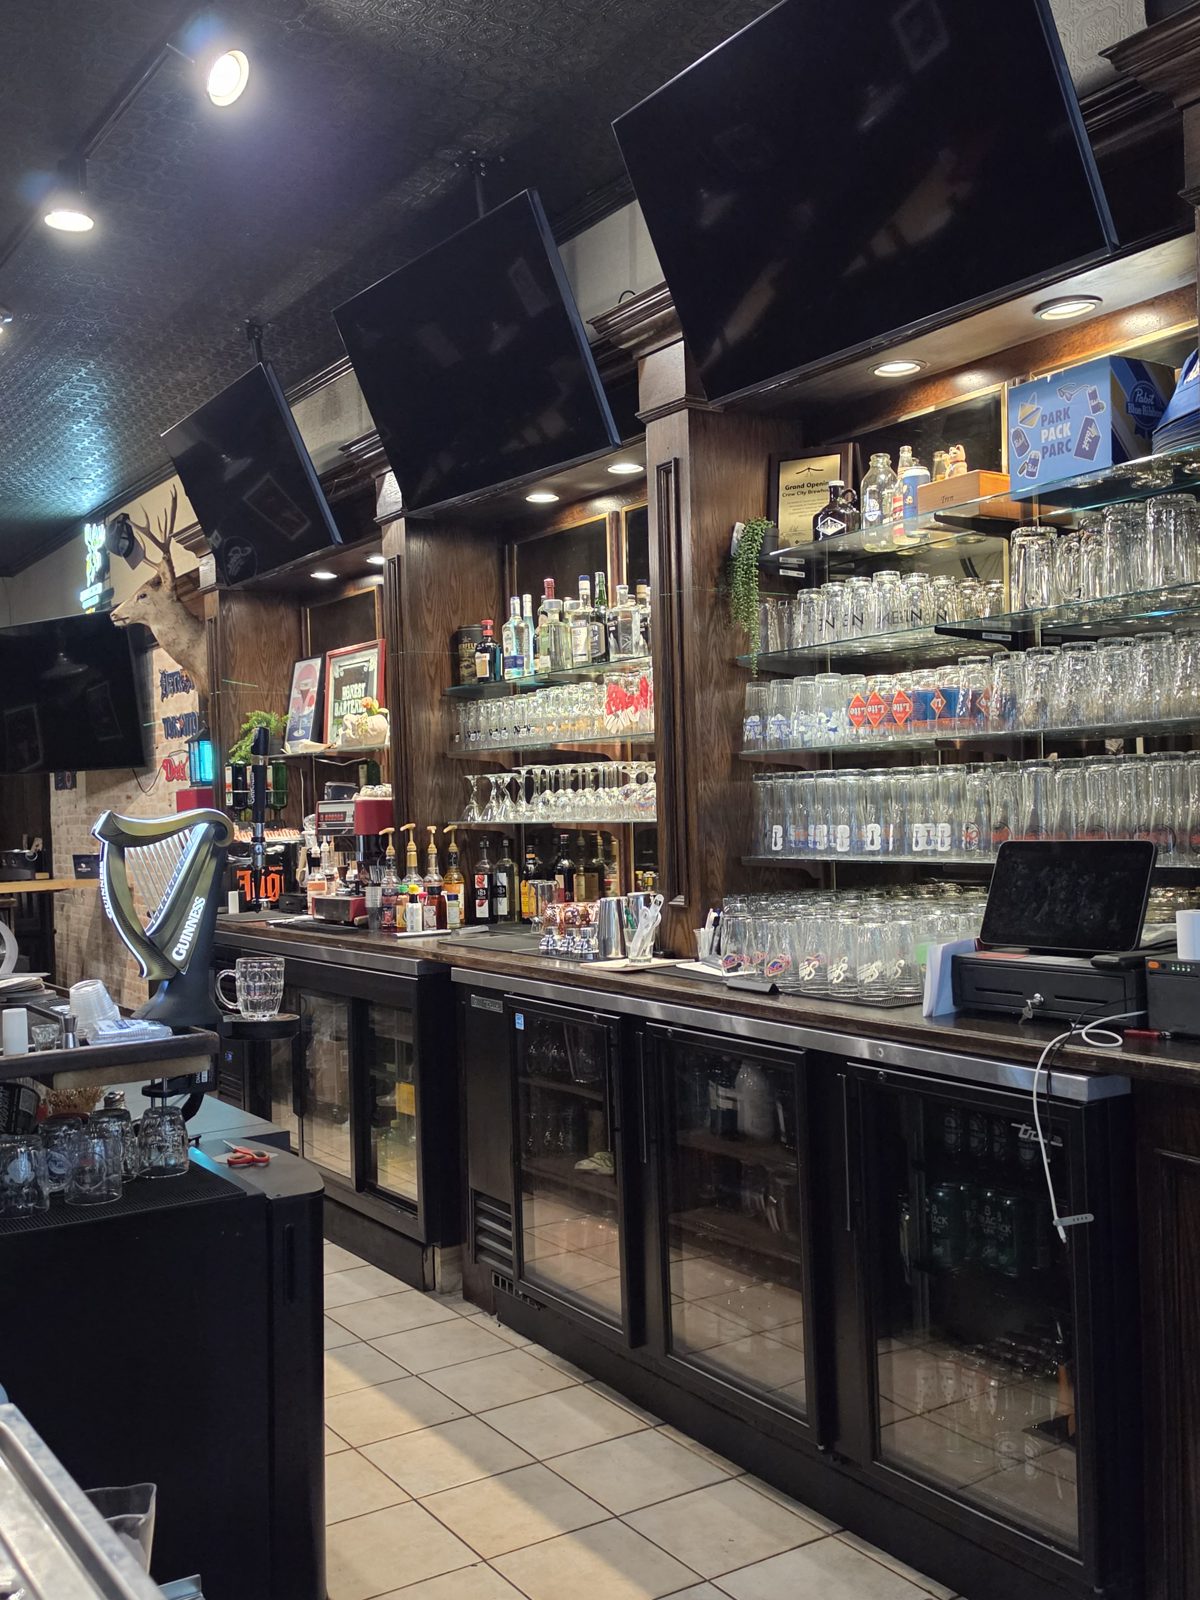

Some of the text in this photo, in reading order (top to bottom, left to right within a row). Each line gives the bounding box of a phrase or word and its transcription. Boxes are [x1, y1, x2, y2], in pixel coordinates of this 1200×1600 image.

[1135, 388, 1155, 405] Pabst
[1128, 402, 1143, 415] Blue
[1041, 406, 1071, 427] PARK
[1041, 421, 1072, 443] PACK
[1041, 438, 1072, 460] PARC
[785, 480, 829, 491] Grand Openin
[850, 707, 867, 717] Lite
[867, 705, 885, 714] Lite
[892, 703, 909, 712] Lite
[171, 896, 206, 961] GUINNESS
